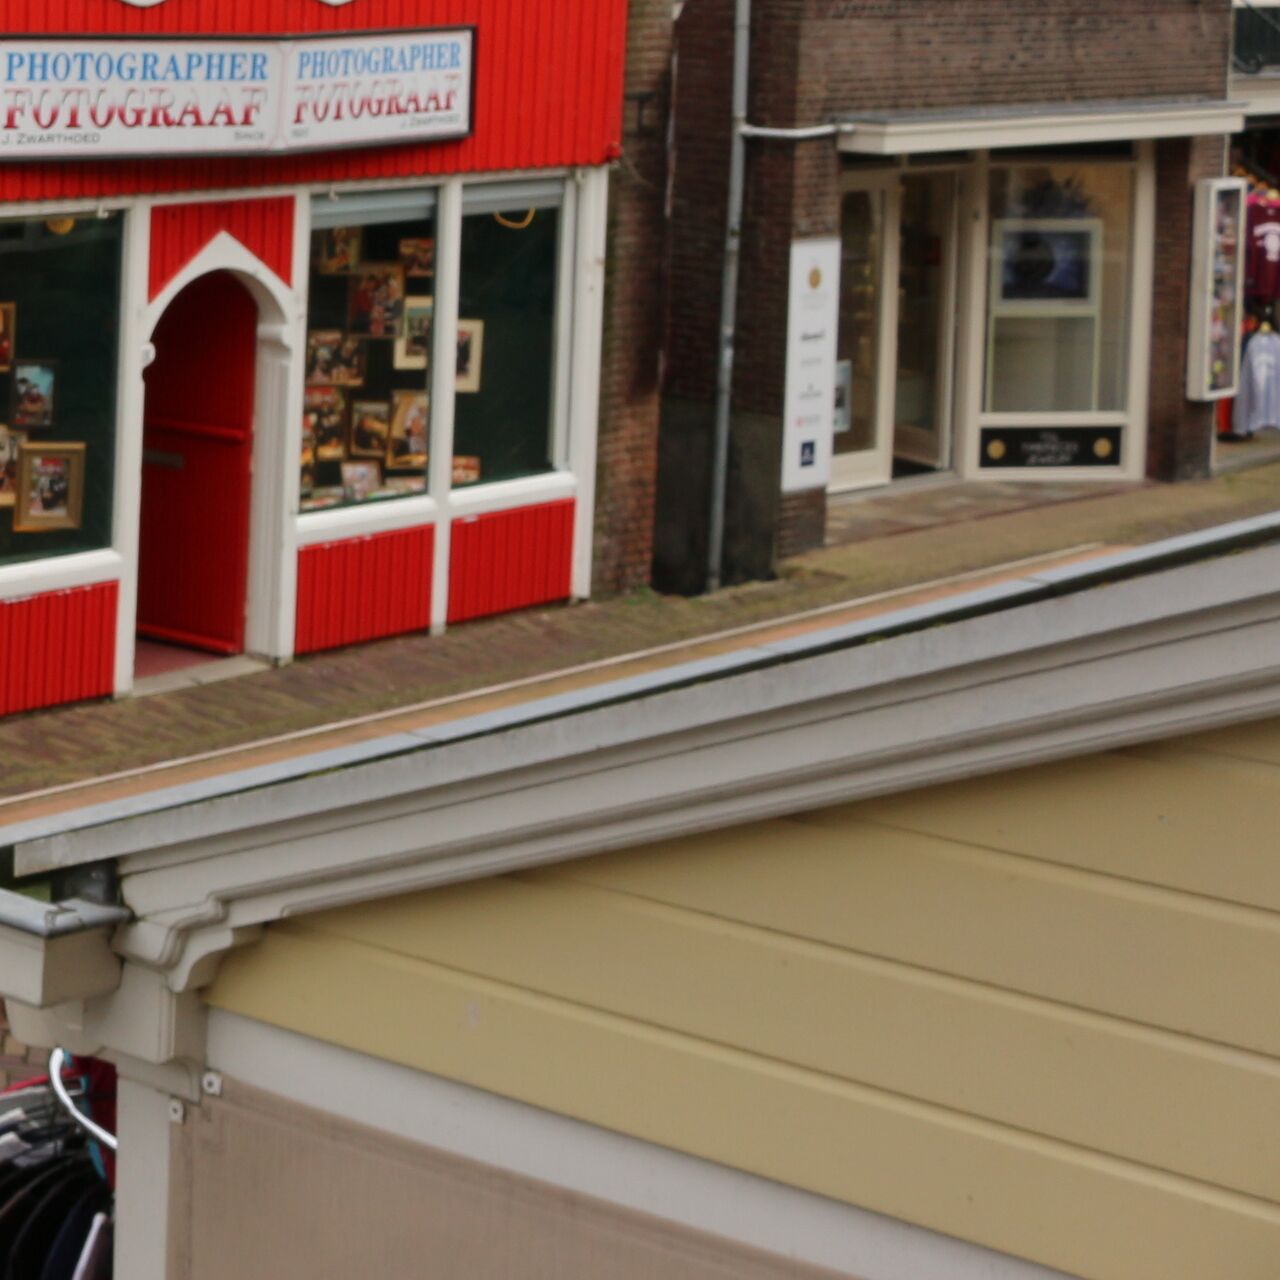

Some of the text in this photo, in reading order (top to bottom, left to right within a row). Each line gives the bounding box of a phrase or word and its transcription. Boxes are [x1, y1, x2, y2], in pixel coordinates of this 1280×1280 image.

[4, 51, 268, 81] PHOTOGRAPHER
[297, 41, 461, 80] PHOTOGRAPHER
[2, 86, 268, 130] FOTOGRAAF
[293, 72, 460, 125] FOTOGRAAF
